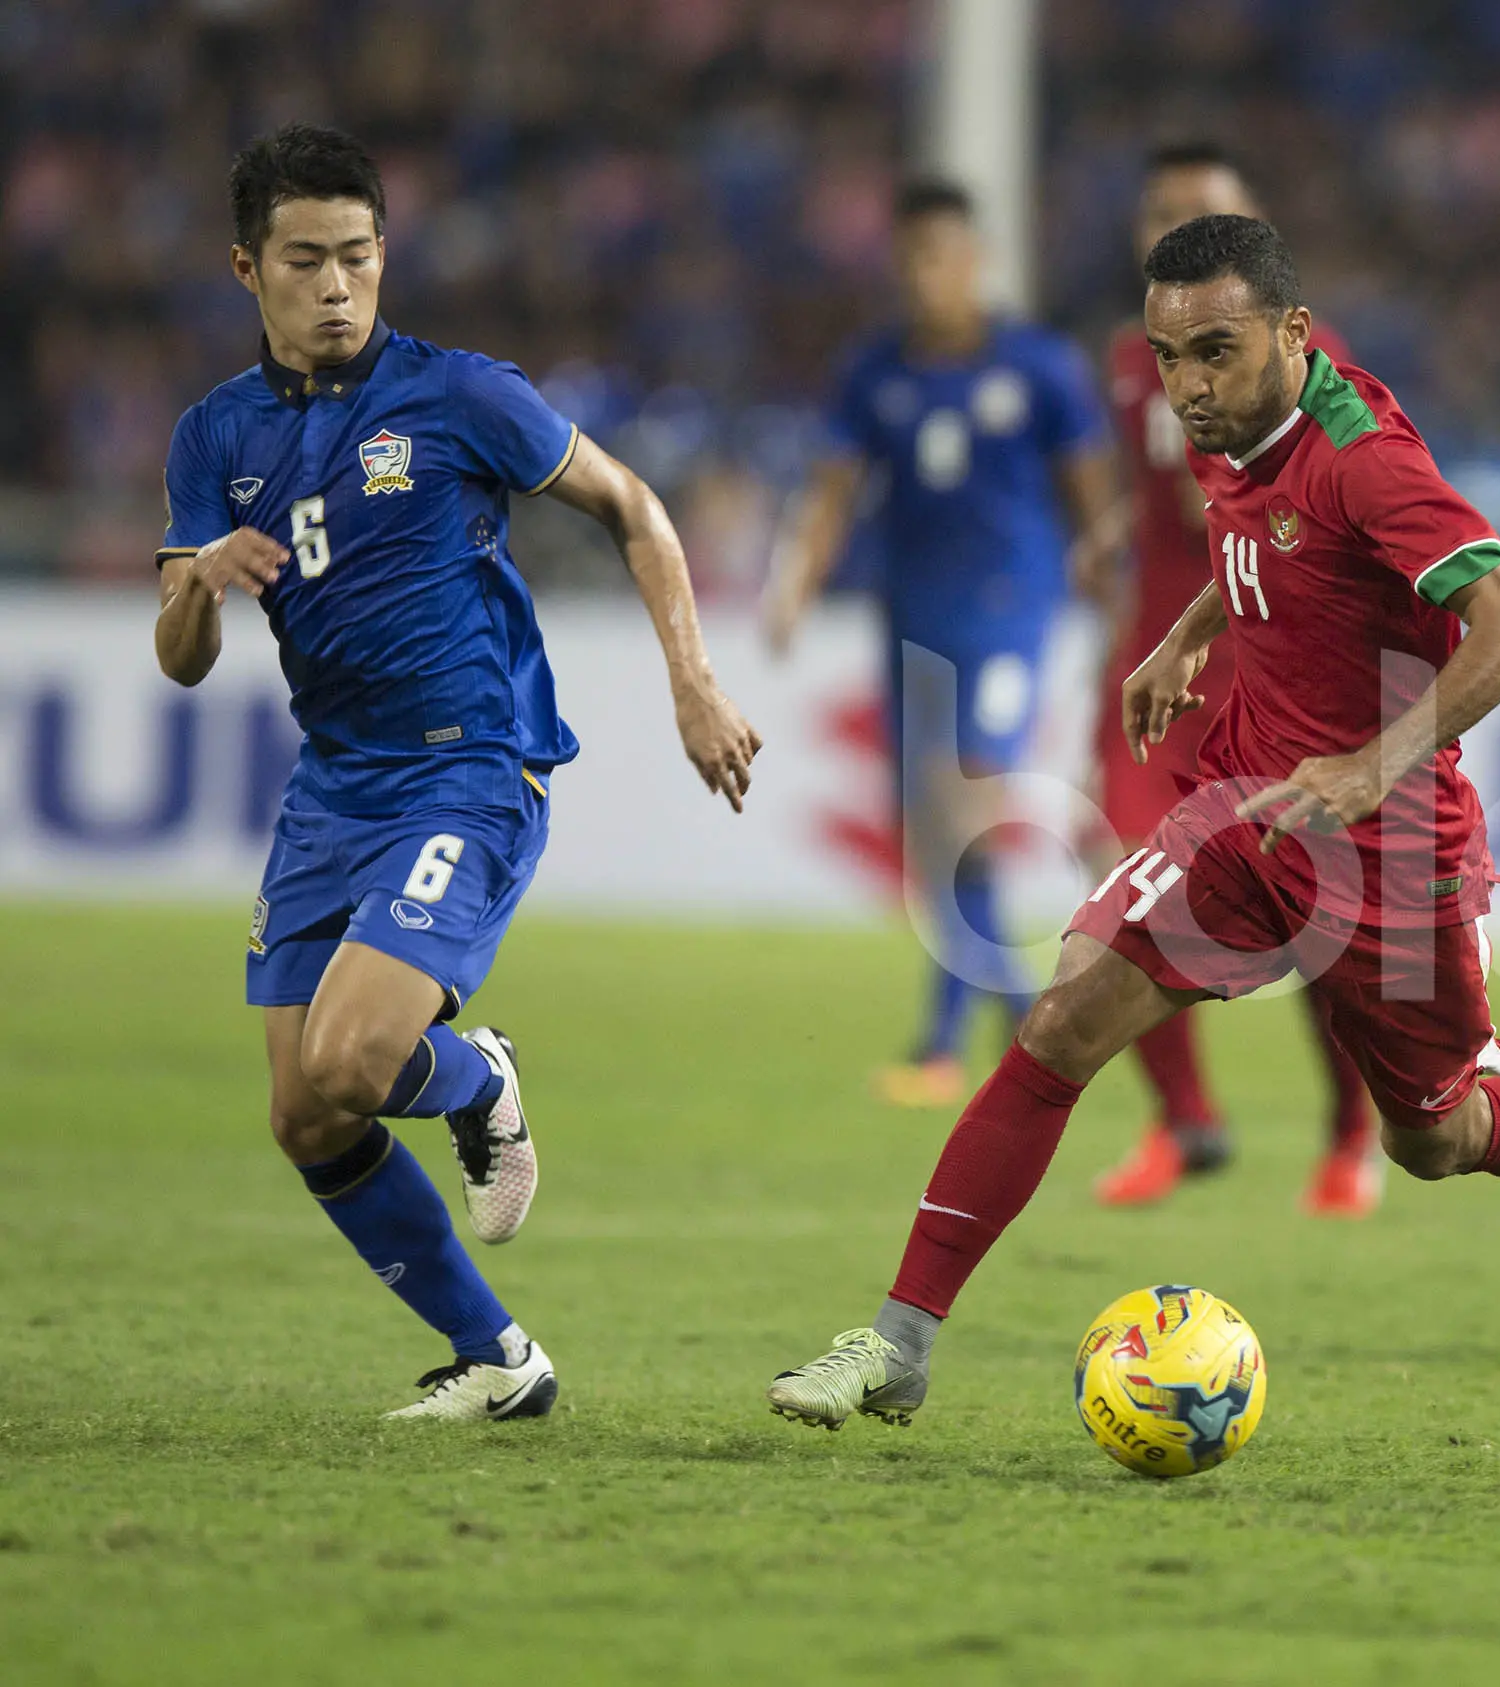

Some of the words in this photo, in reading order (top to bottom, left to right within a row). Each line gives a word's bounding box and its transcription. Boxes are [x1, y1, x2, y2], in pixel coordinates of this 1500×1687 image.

[290, 495, 331, 578] 6
[1222, 531, 1270, 621] 14
[402, 833, 465, 904] 6
[1087, 847, 1184, 922] 14
[1092, 1396, 1167, 1462] mitre
